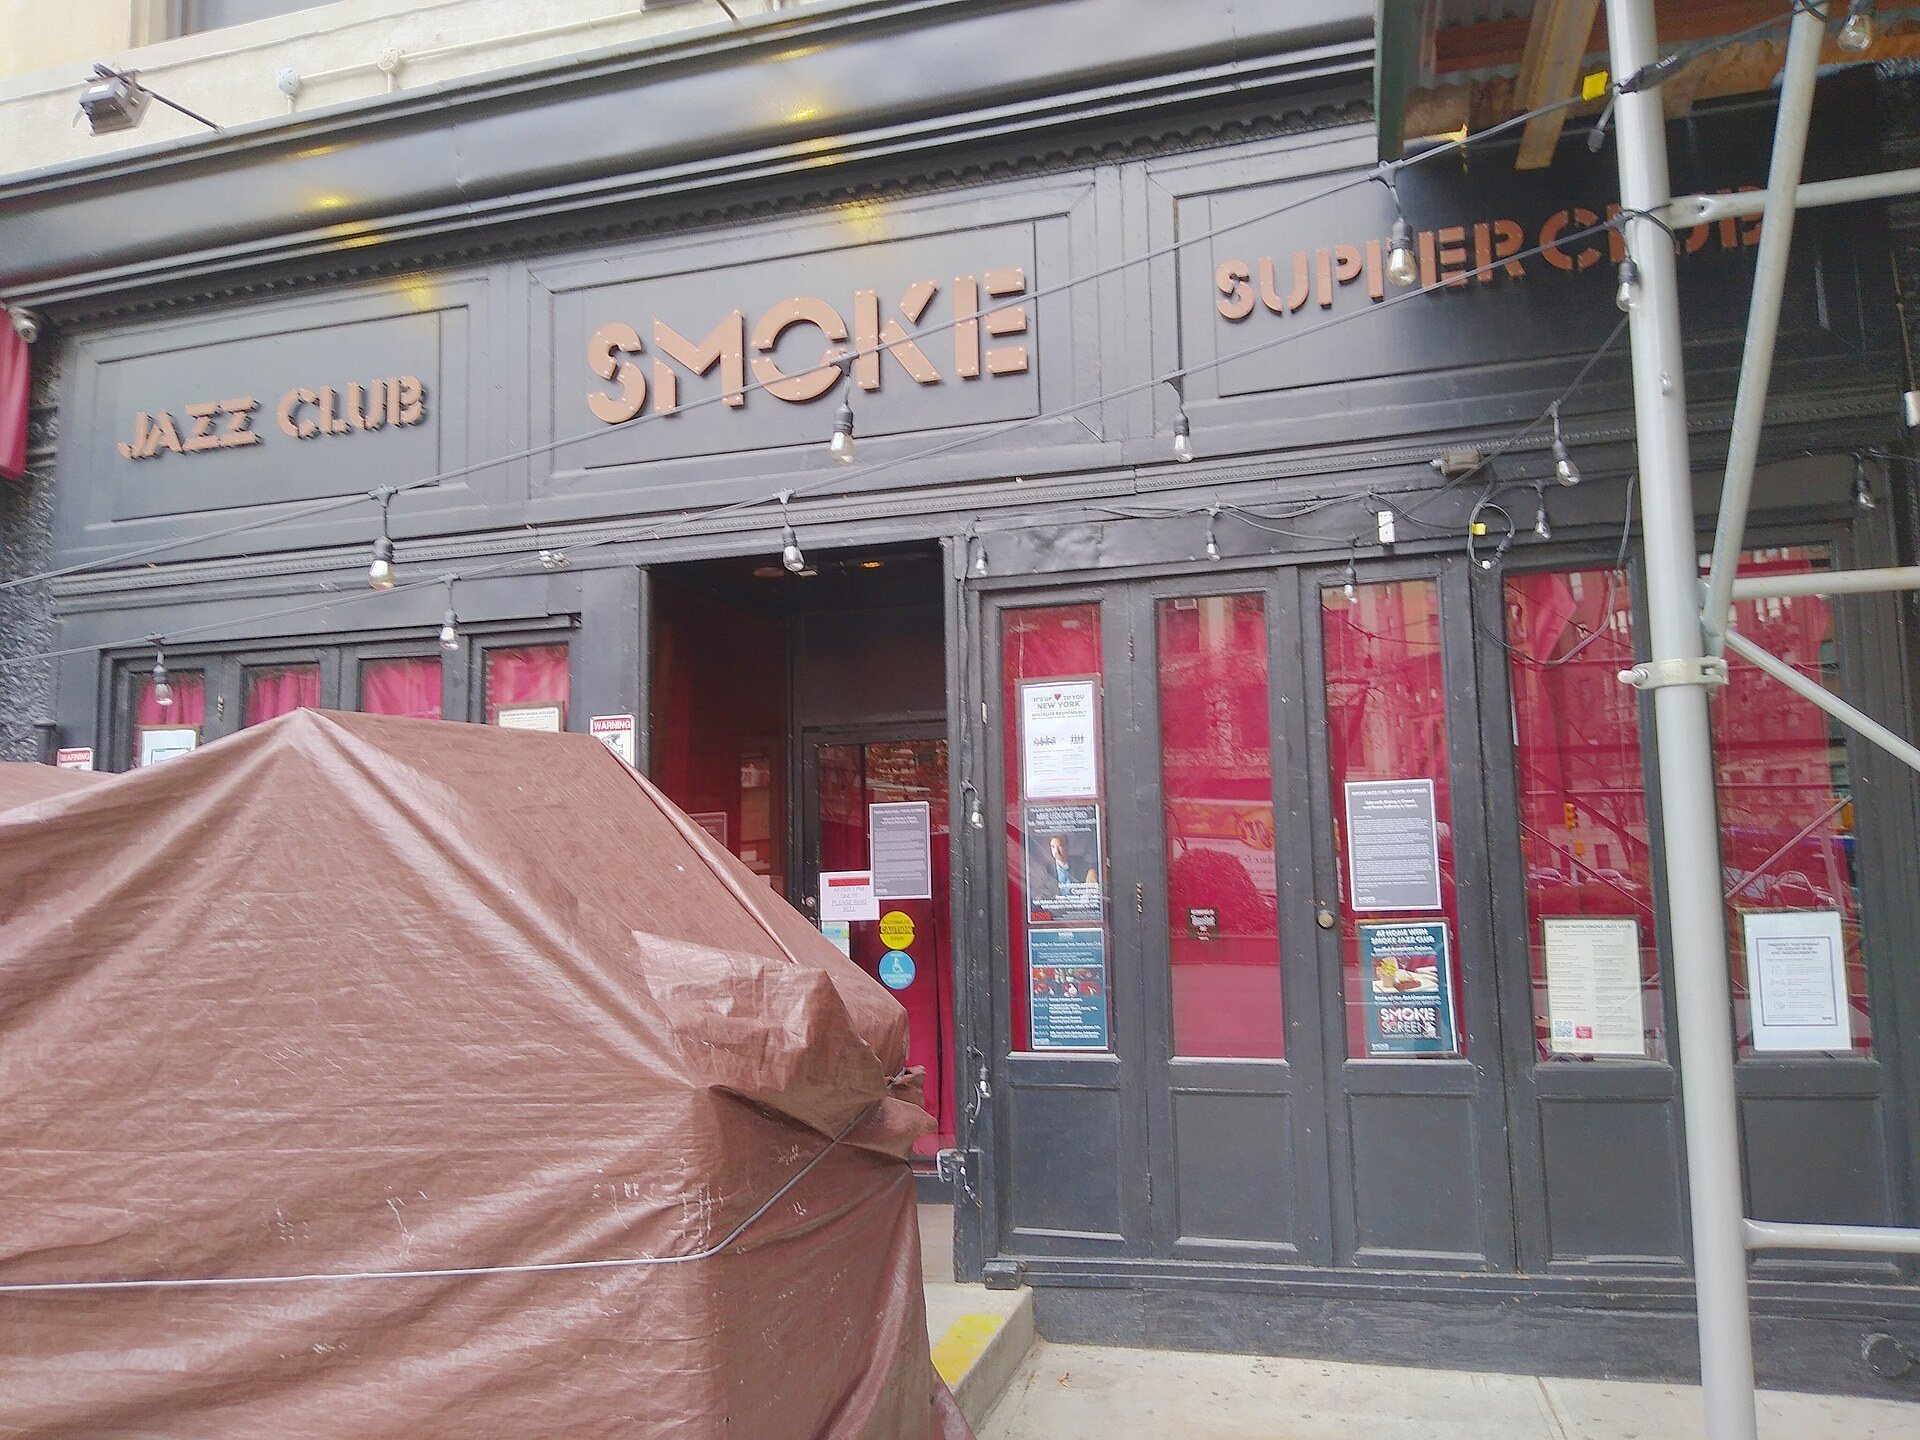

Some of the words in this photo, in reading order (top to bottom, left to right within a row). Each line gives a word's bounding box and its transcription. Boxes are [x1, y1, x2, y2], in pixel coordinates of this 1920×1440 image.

[585, 266, 1030, 425] SMOKE
[117, 395, 262, 460] JAZZ
[277, 374, 426, 440] CLUB
[594, 720, 631, 730] WARNING
[60, 753, 90, 762] WARNING
[1397, 936, 1416, 944] JAZZ
[1380, 1007, 1436, 1021] SMOKE
